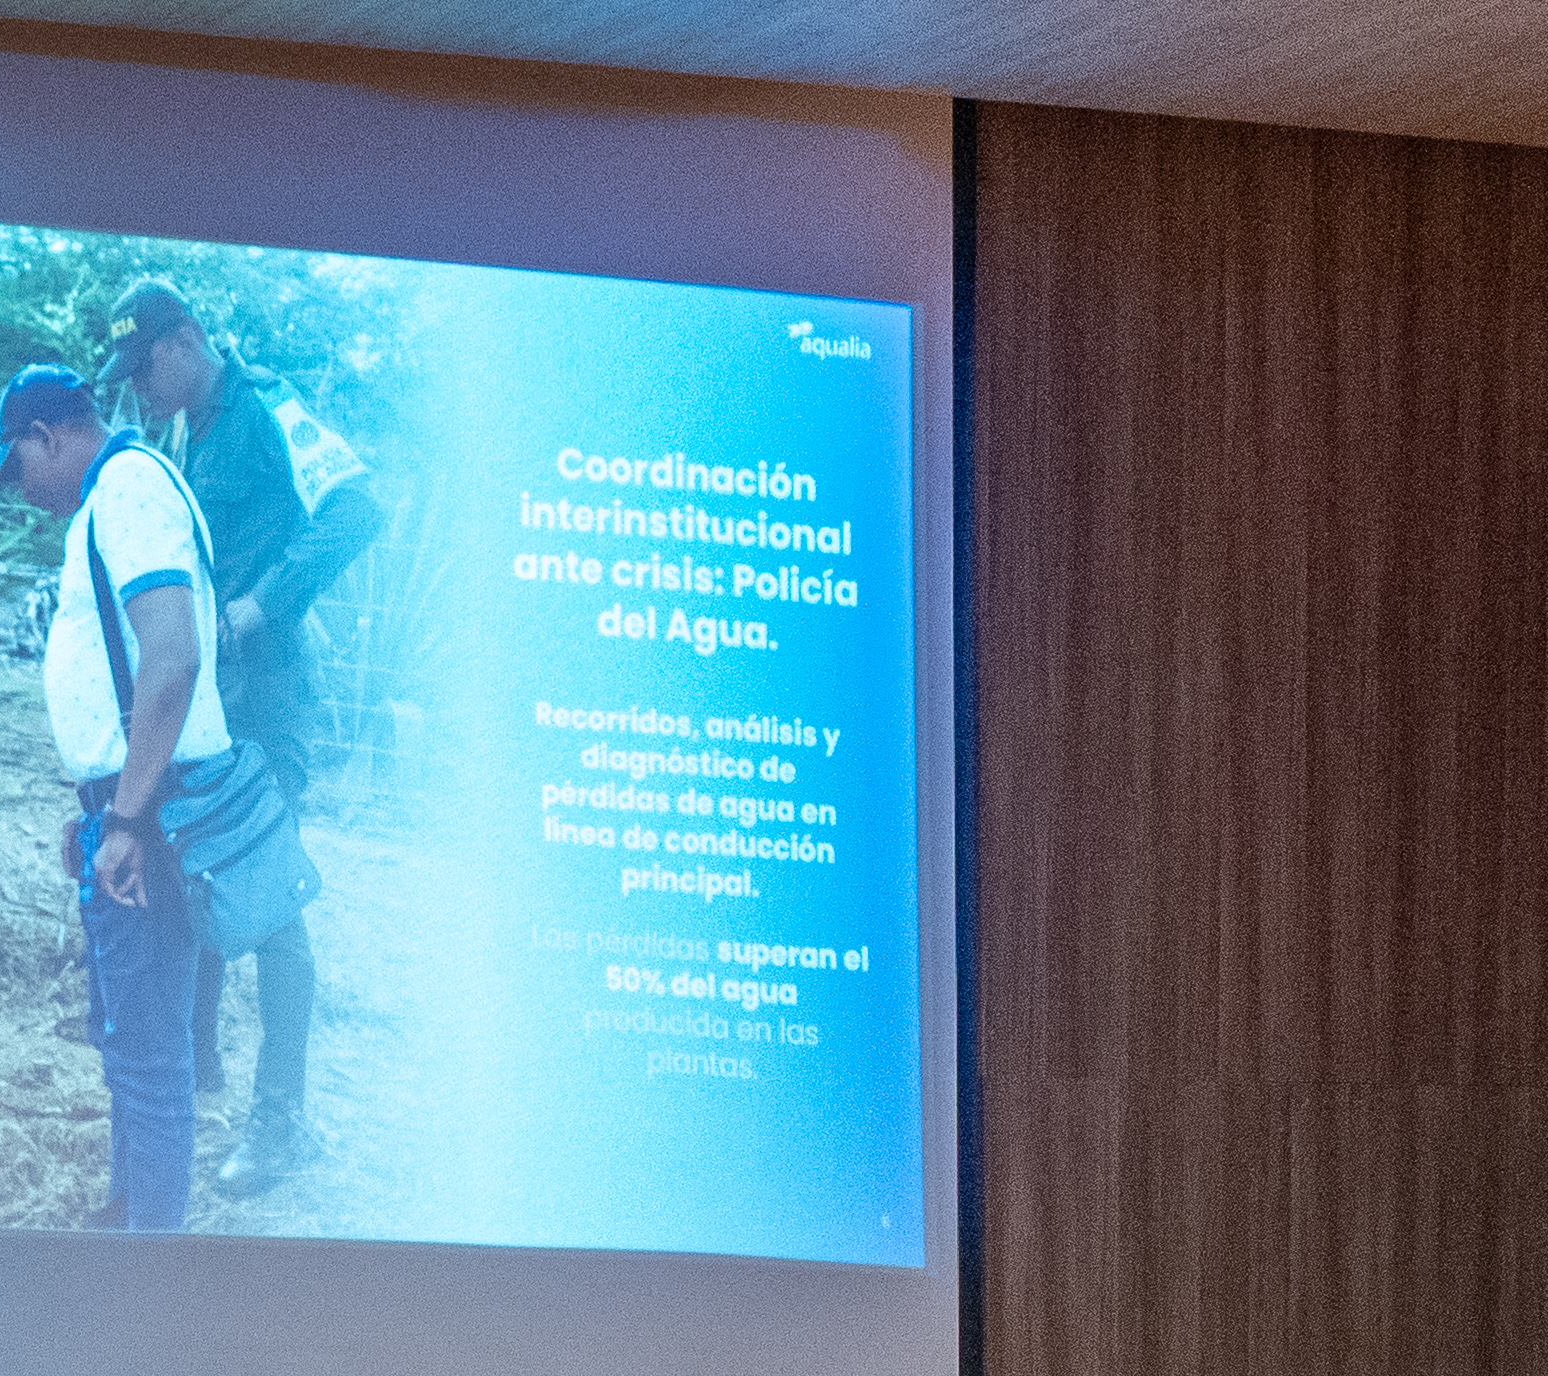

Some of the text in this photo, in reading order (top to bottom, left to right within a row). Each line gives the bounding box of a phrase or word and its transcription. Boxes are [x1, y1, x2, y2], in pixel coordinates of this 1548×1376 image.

[800, 334, 871, 361] aqualia
[557, 447, 817, 502] Coordinación
[520, 491, 852, 556] interinstitucional
[513, 550, 858, 608] ante crisis: Policía
[597, 604, 779, 656] del Agua.
[535, 701, 841, 756] Recorridos, análisis y
[580, 743, 796, 784] diagnóstico de
[541, 782, 837, 828] pérdidas de agua en
[543, 816, 835, 862] línea de conducción
[621, 864, 760, 903] principal.
[717, 939, 837, 972] superan
[842, 944, 870, 974] el
[605, 963, 798, 1012] 50% del agua
[583, 1005, 819, 1047] producida en las
[646, 1047, 759, 1082] plantas.
